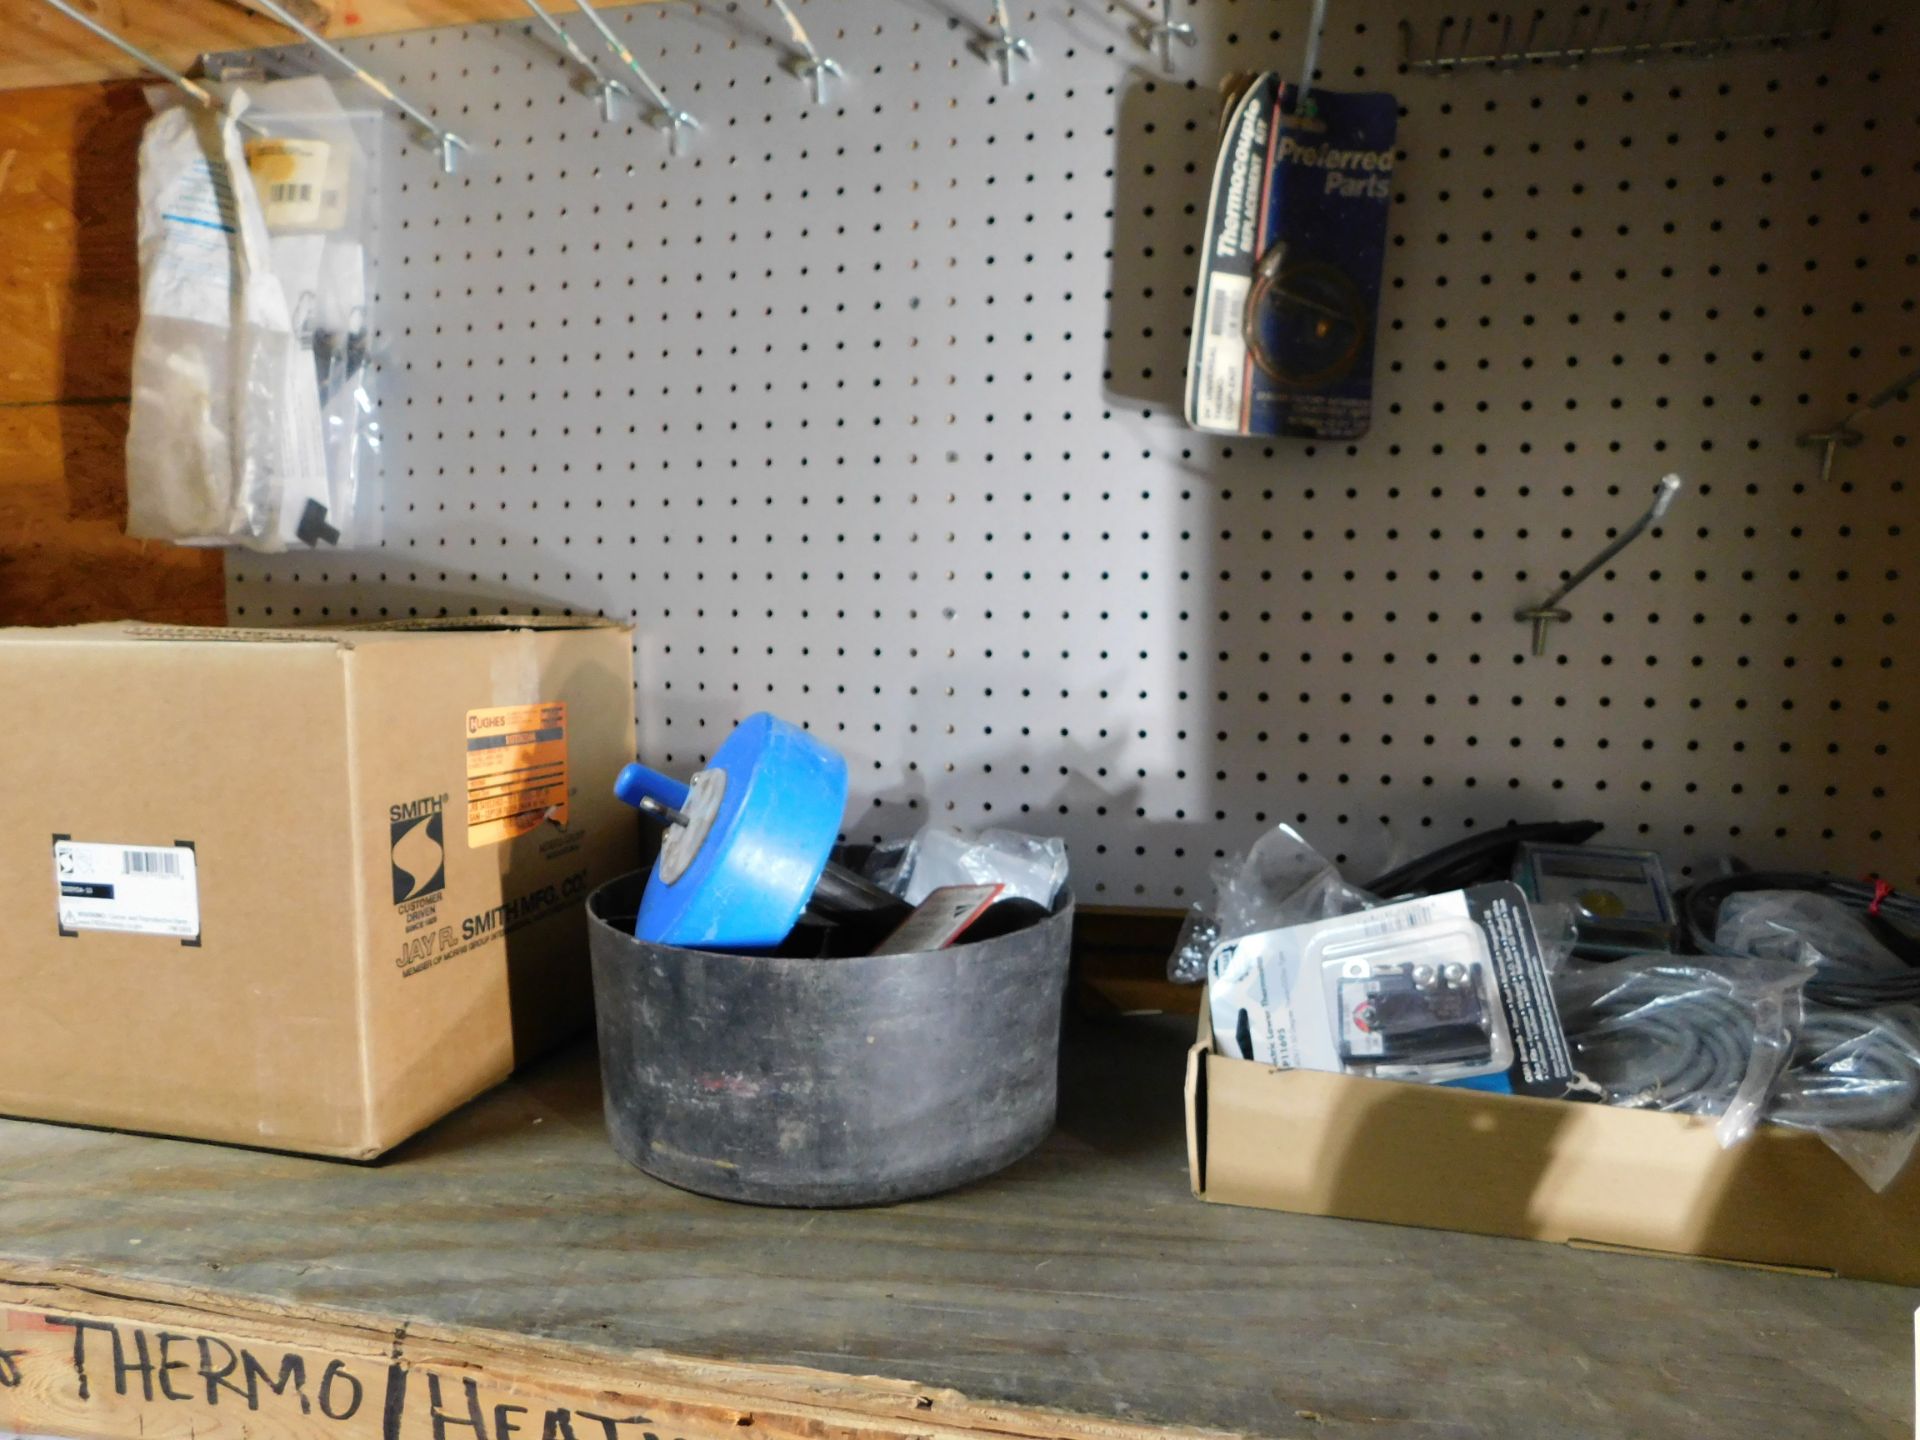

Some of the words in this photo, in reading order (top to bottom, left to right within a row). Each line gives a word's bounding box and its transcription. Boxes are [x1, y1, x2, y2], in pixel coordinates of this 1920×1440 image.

[1277, 136, 1395, 172] Preferred
[1216, 98, 1261, 257] Thermocouple
[1324, 171, 1391, 197] Parts
[469, 714, 506, 733] HUGHES
[397, 891, 444, 916] CUSTOMER
[406, 905, 436, 924] DRIVEN
[395, 931, 436, 969] JAY
[438, 926, 459, 951] R.
[461, 899, 519, 941] SMITH
[45, 1315, 363, 1420] THERMO
